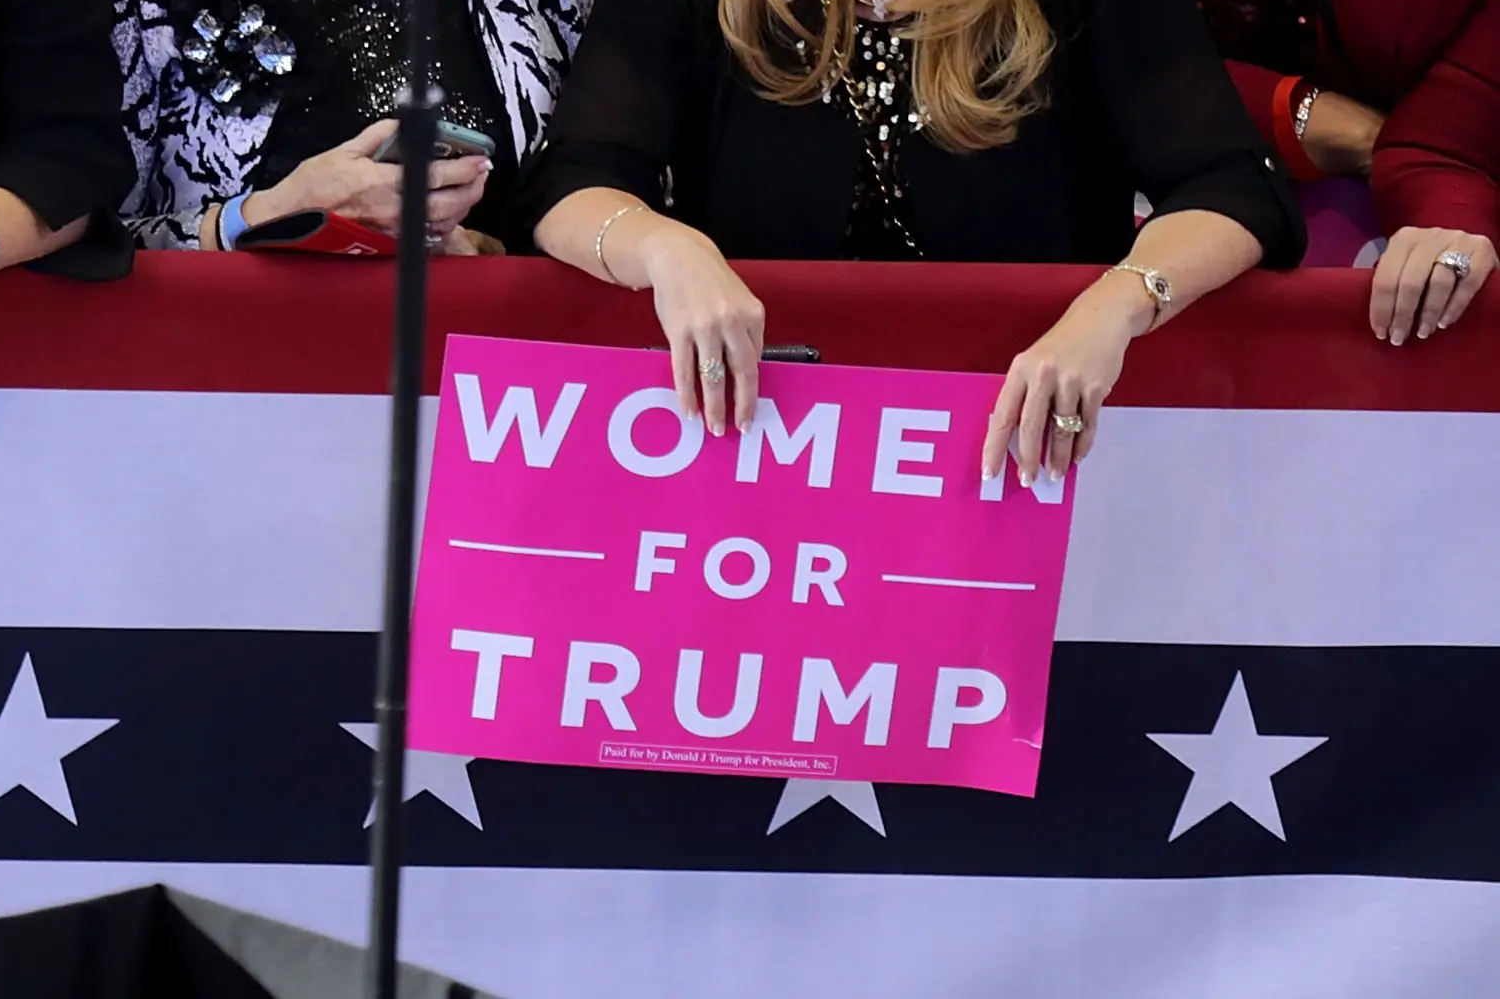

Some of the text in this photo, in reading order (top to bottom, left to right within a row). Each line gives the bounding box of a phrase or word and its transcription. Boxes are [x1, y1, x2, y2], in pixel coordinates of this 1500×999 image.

[634, 530, 849, 607] FOR
[450, 629, 1008, 749] TRUMP
[603, 745, 832, 770] Paid for by Donald J Trump for President, Inc.
